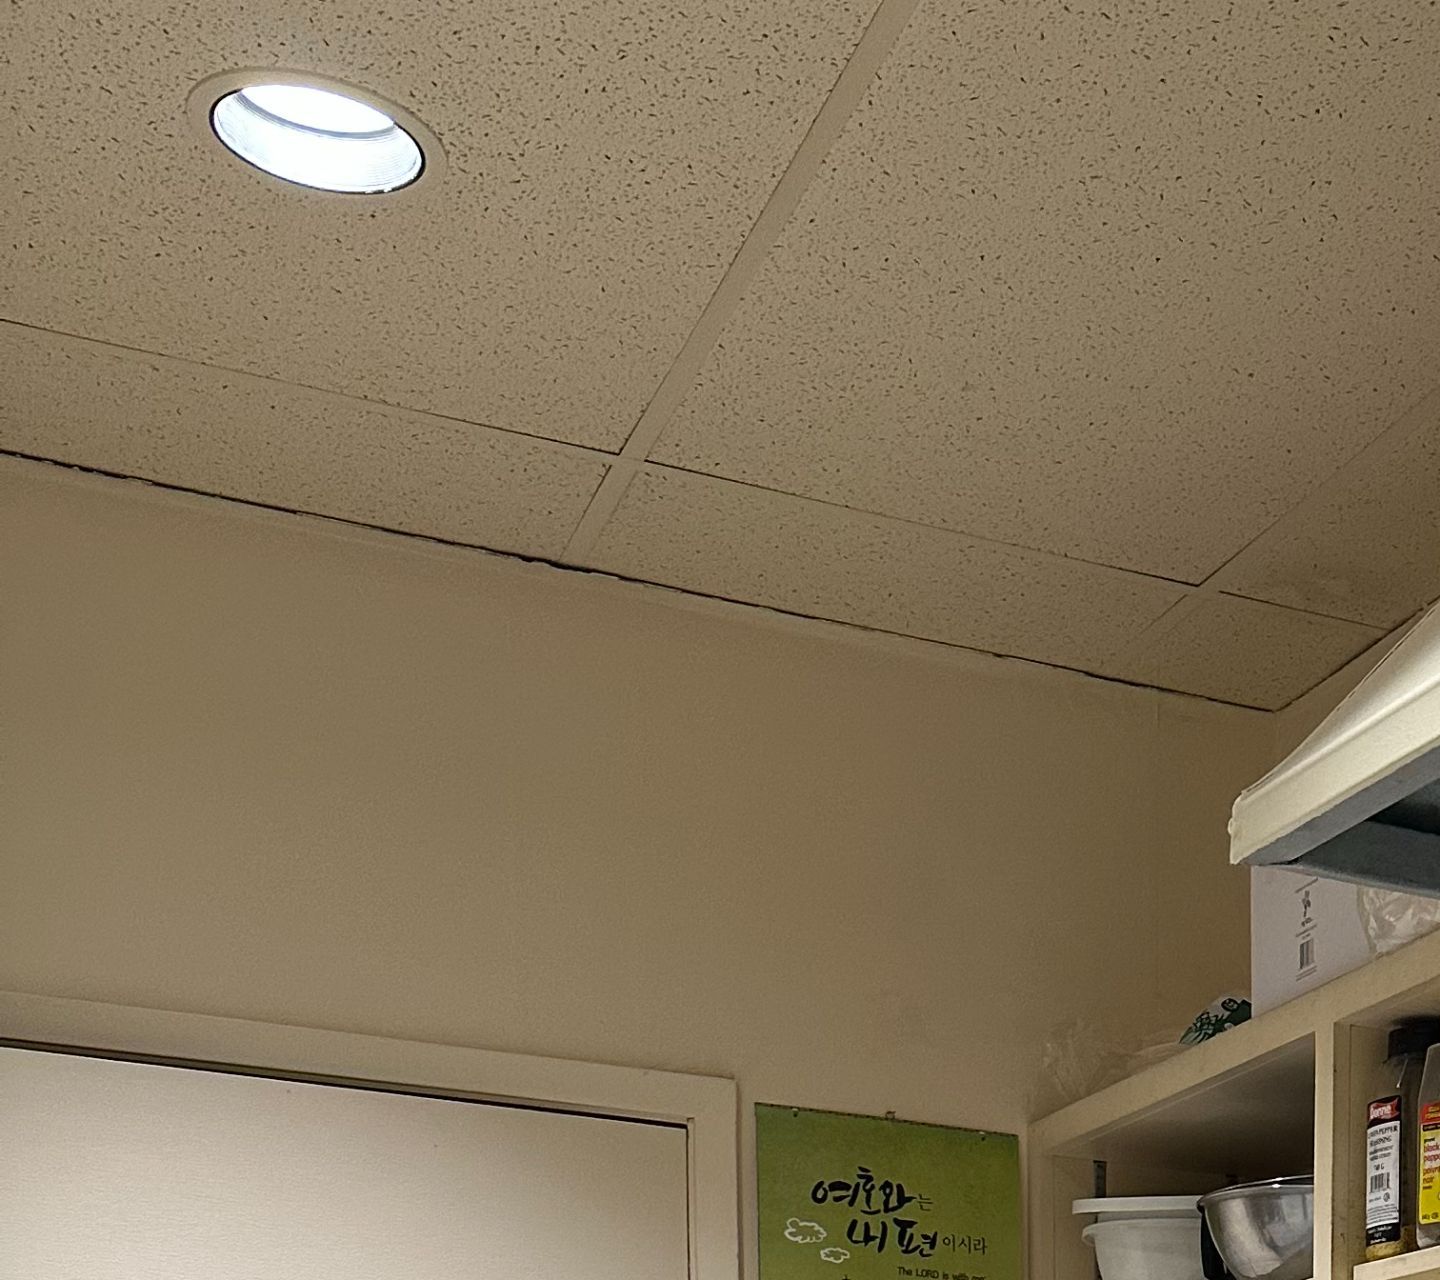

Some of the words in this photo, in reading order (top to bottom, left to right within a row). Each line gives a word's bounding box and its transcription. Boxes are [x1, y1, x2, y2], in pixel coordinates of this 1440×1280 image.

[811, 1166, 933, 1215] 여호와는
[847, 1218, 888, 1253] 내
[897, 1266, 912, 1276] The
[916, 1268, 939, 1279] LORD
[942, 1271, 949, 1280] is
